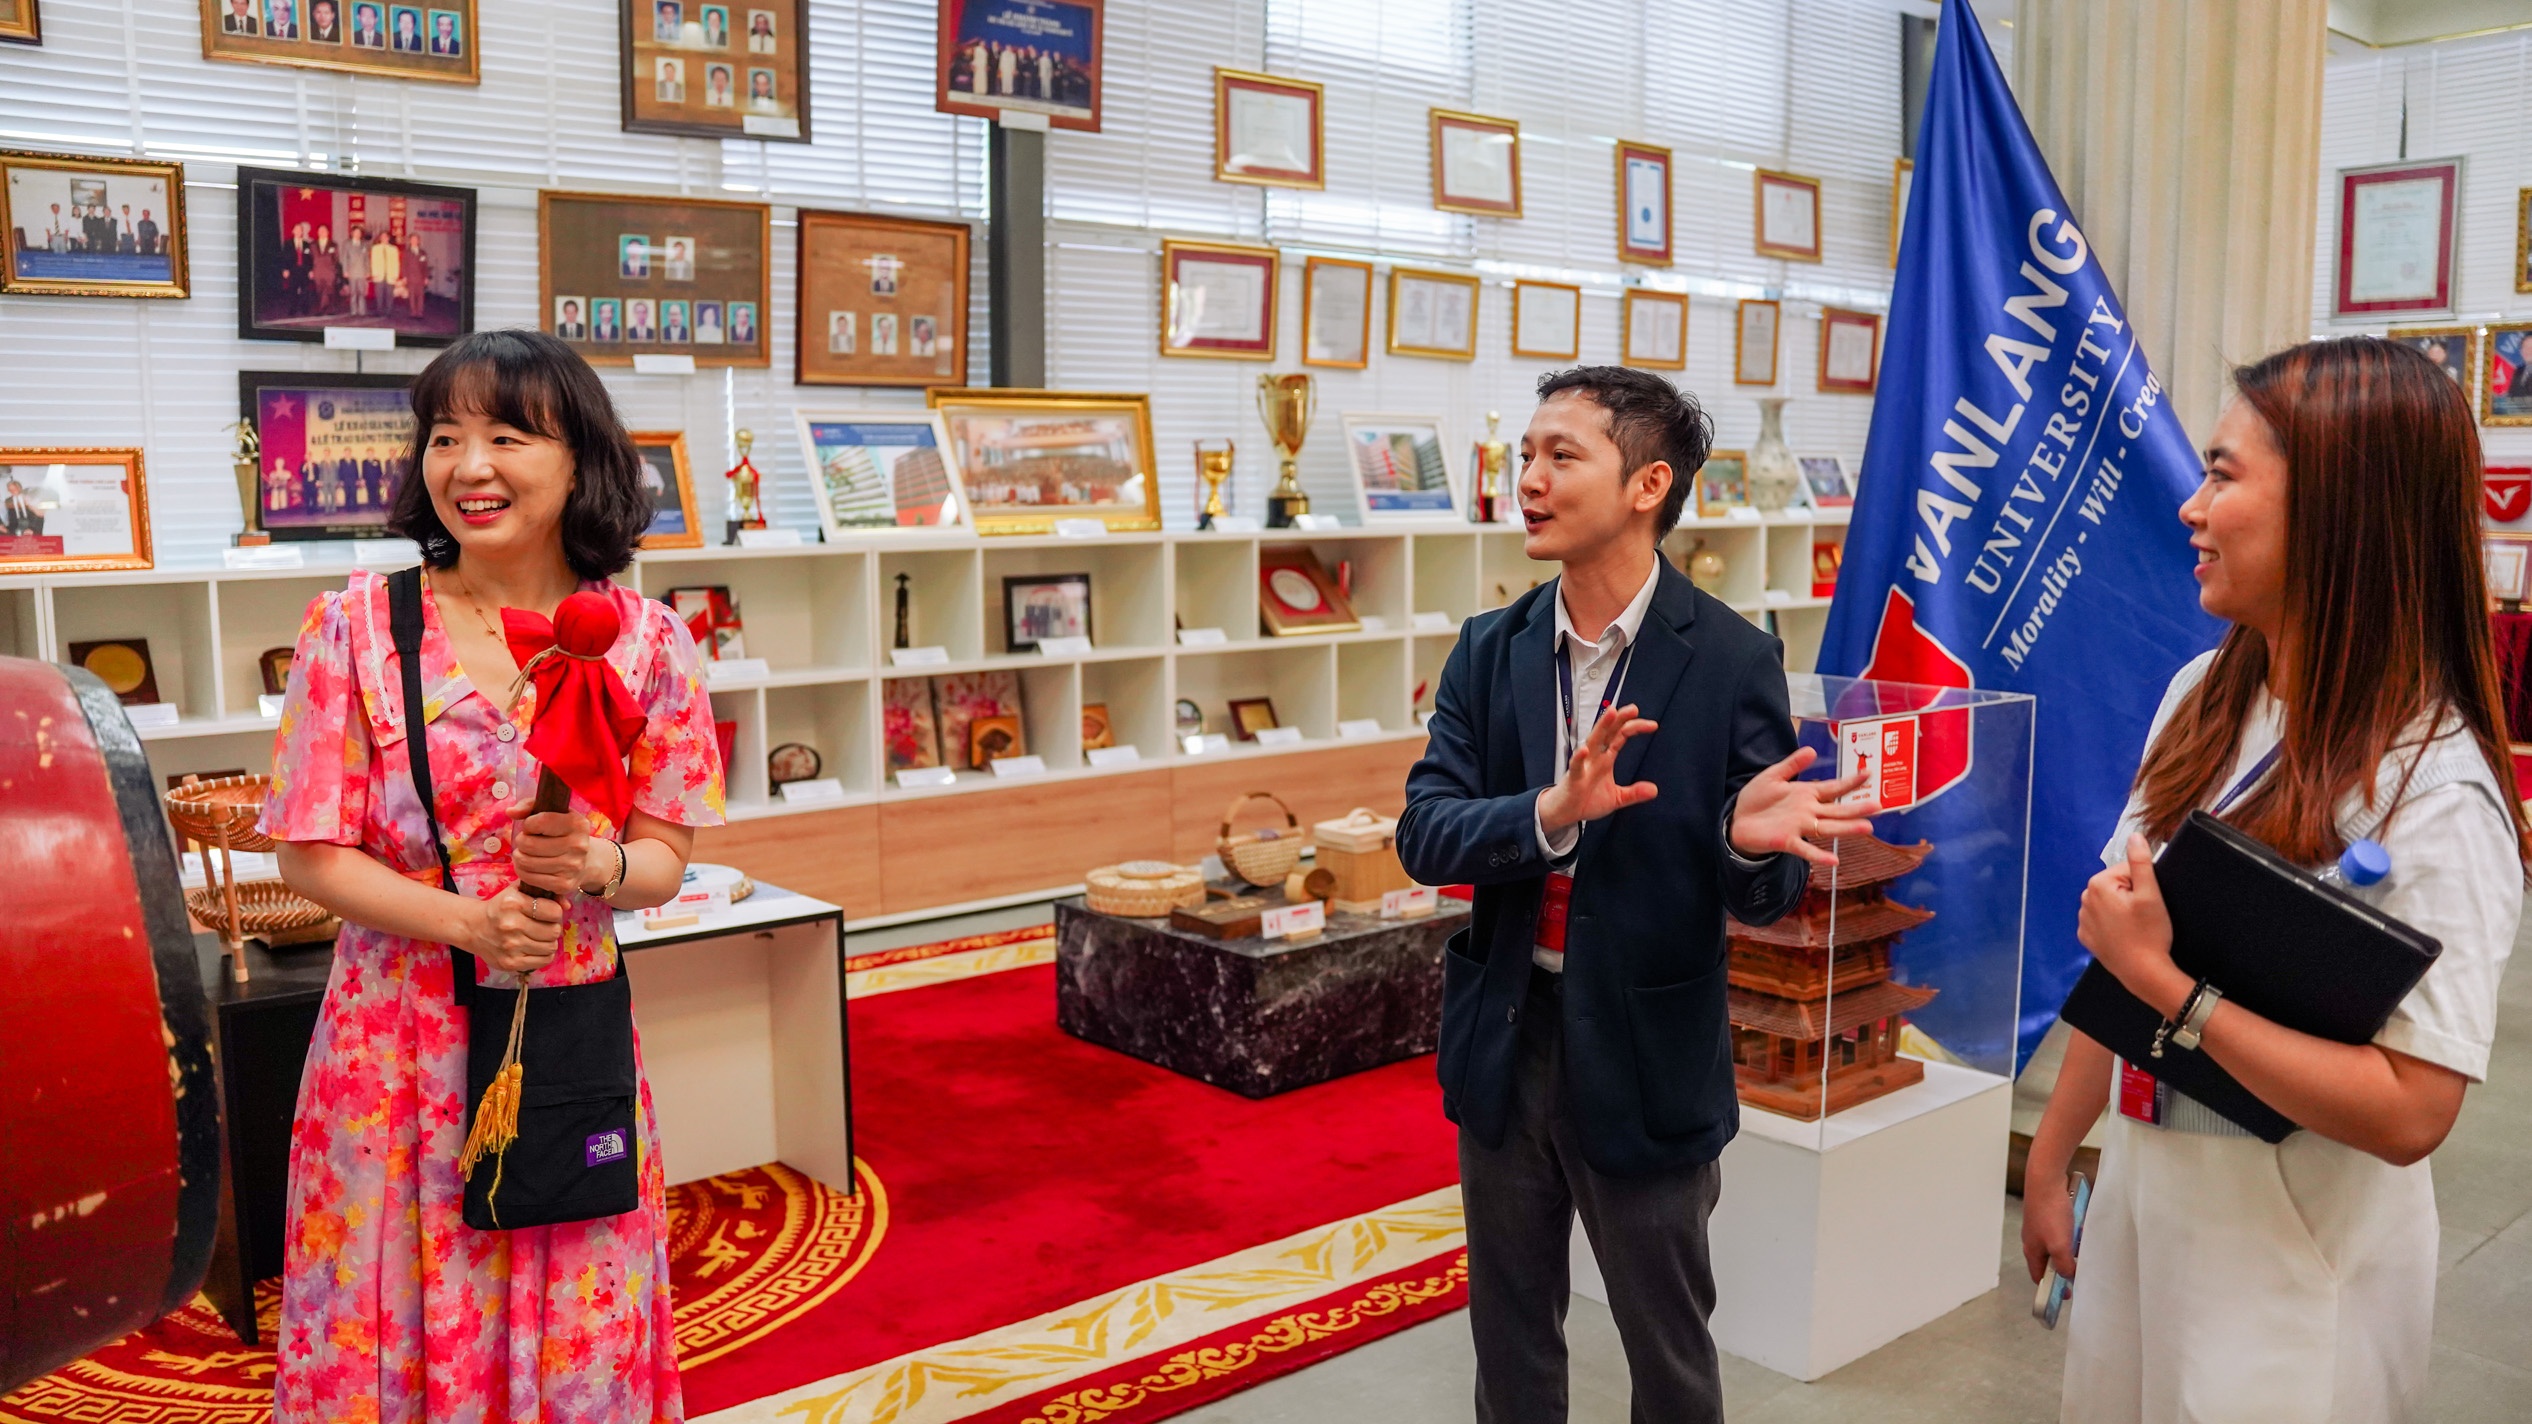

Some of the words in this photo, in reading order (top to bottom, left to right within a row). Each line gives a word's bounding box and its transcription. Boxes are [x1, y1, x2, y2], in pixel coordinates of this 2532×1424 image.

[1964, 294, 2124, 594] UNIVERSITY
[2000, 546, 2082, 672] Morality
[2077, 457, 2123, 525] Will
[599, 1134, 612, 1143] THE
[590, 1142, 612, 1153] NORTH
[596, 1149, 612, 1159] FACE
